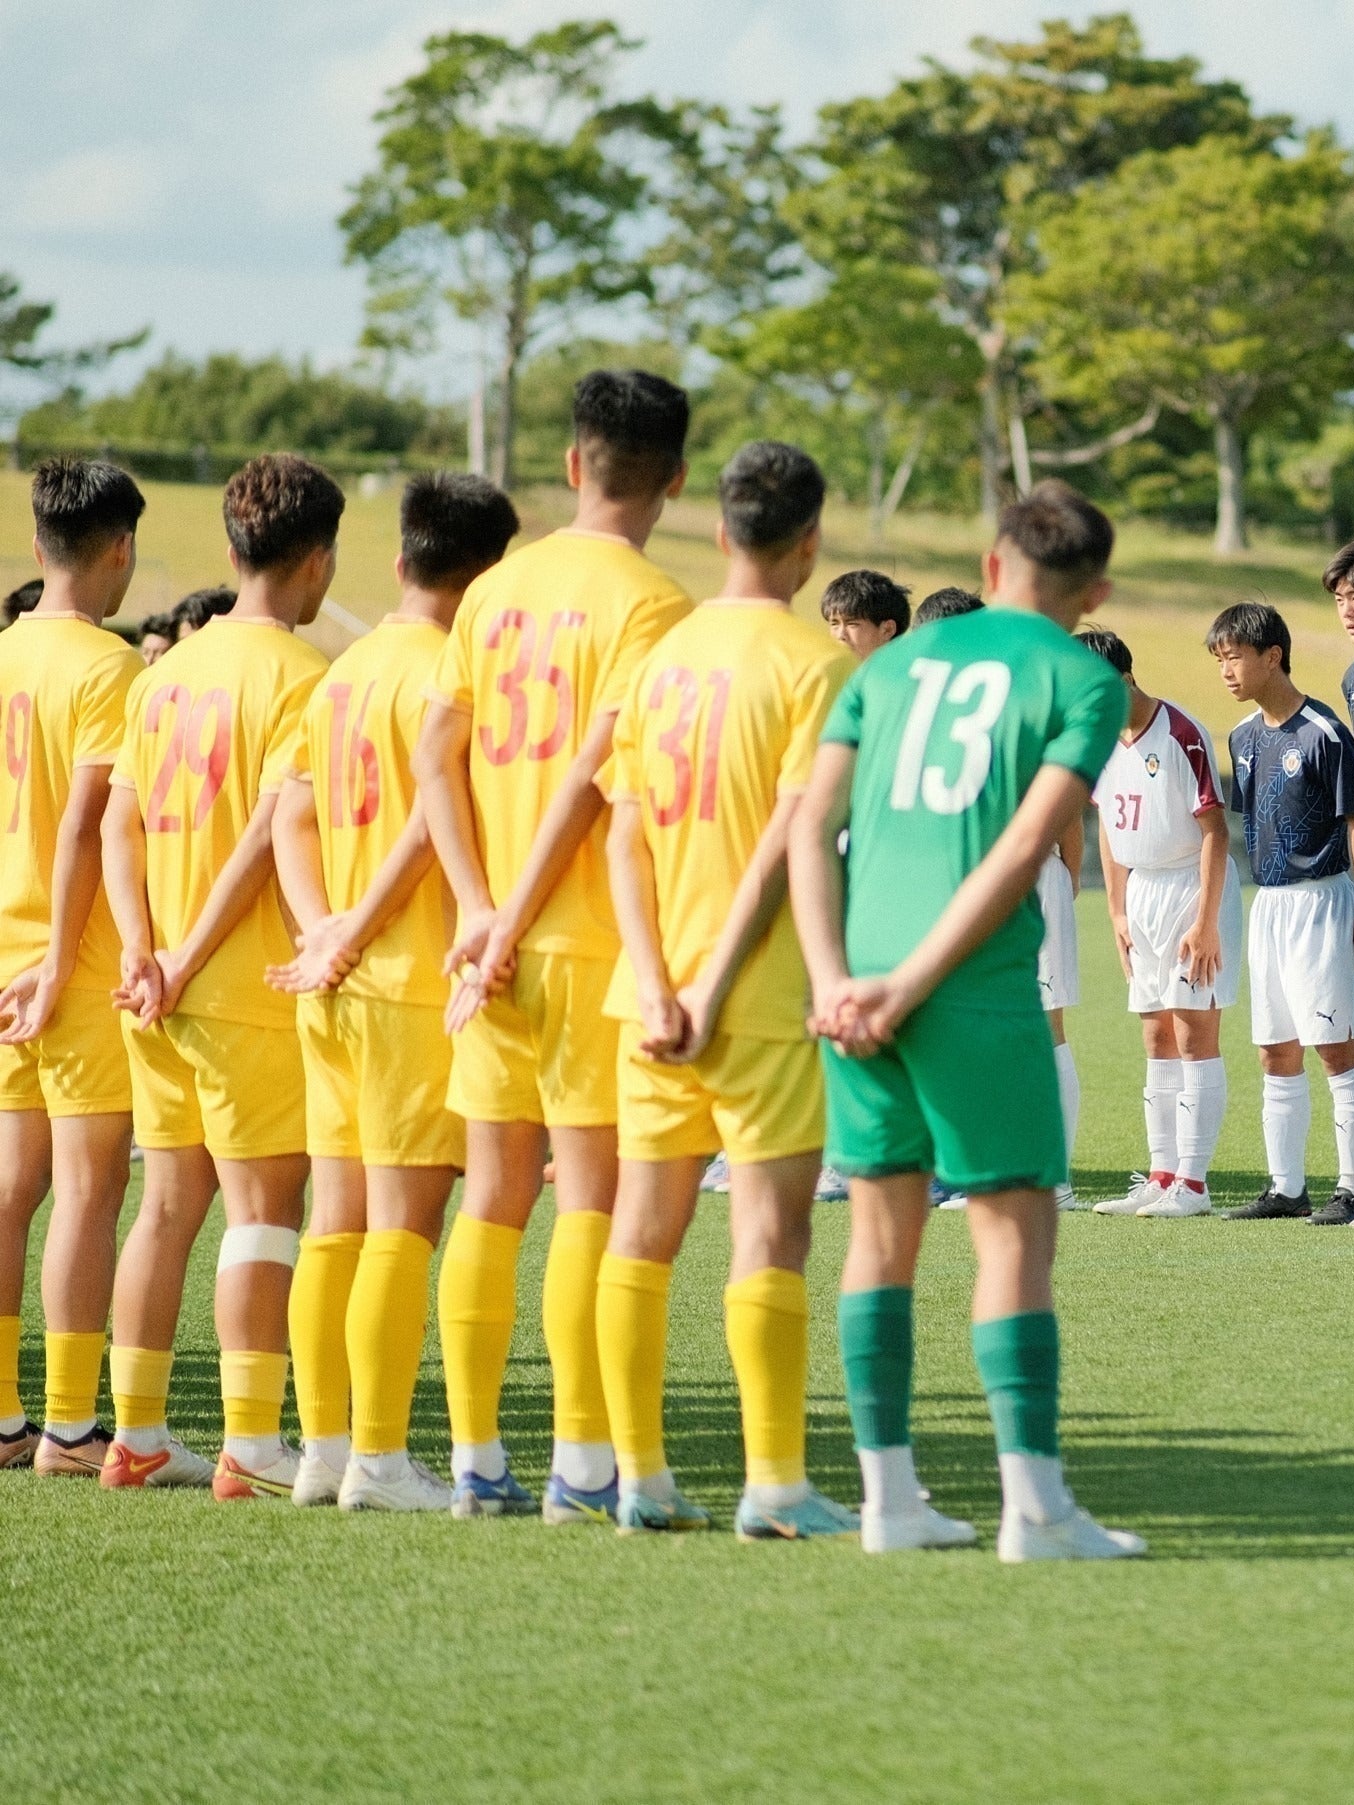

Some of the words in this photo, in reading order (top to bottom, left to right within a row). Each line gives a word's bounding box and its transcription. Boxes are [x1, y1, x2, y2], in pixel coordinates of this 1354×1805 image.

[0, 691, 31, 834] 9
[144, 684, 232, 834] 29
[326, 680, 379, 829] 16
[479, 608, 587, 767] 35
[646, 667, 733, 828] 31
[889, 656, 1011, 815] 13
[1114, 793, 1143, 832] 37
